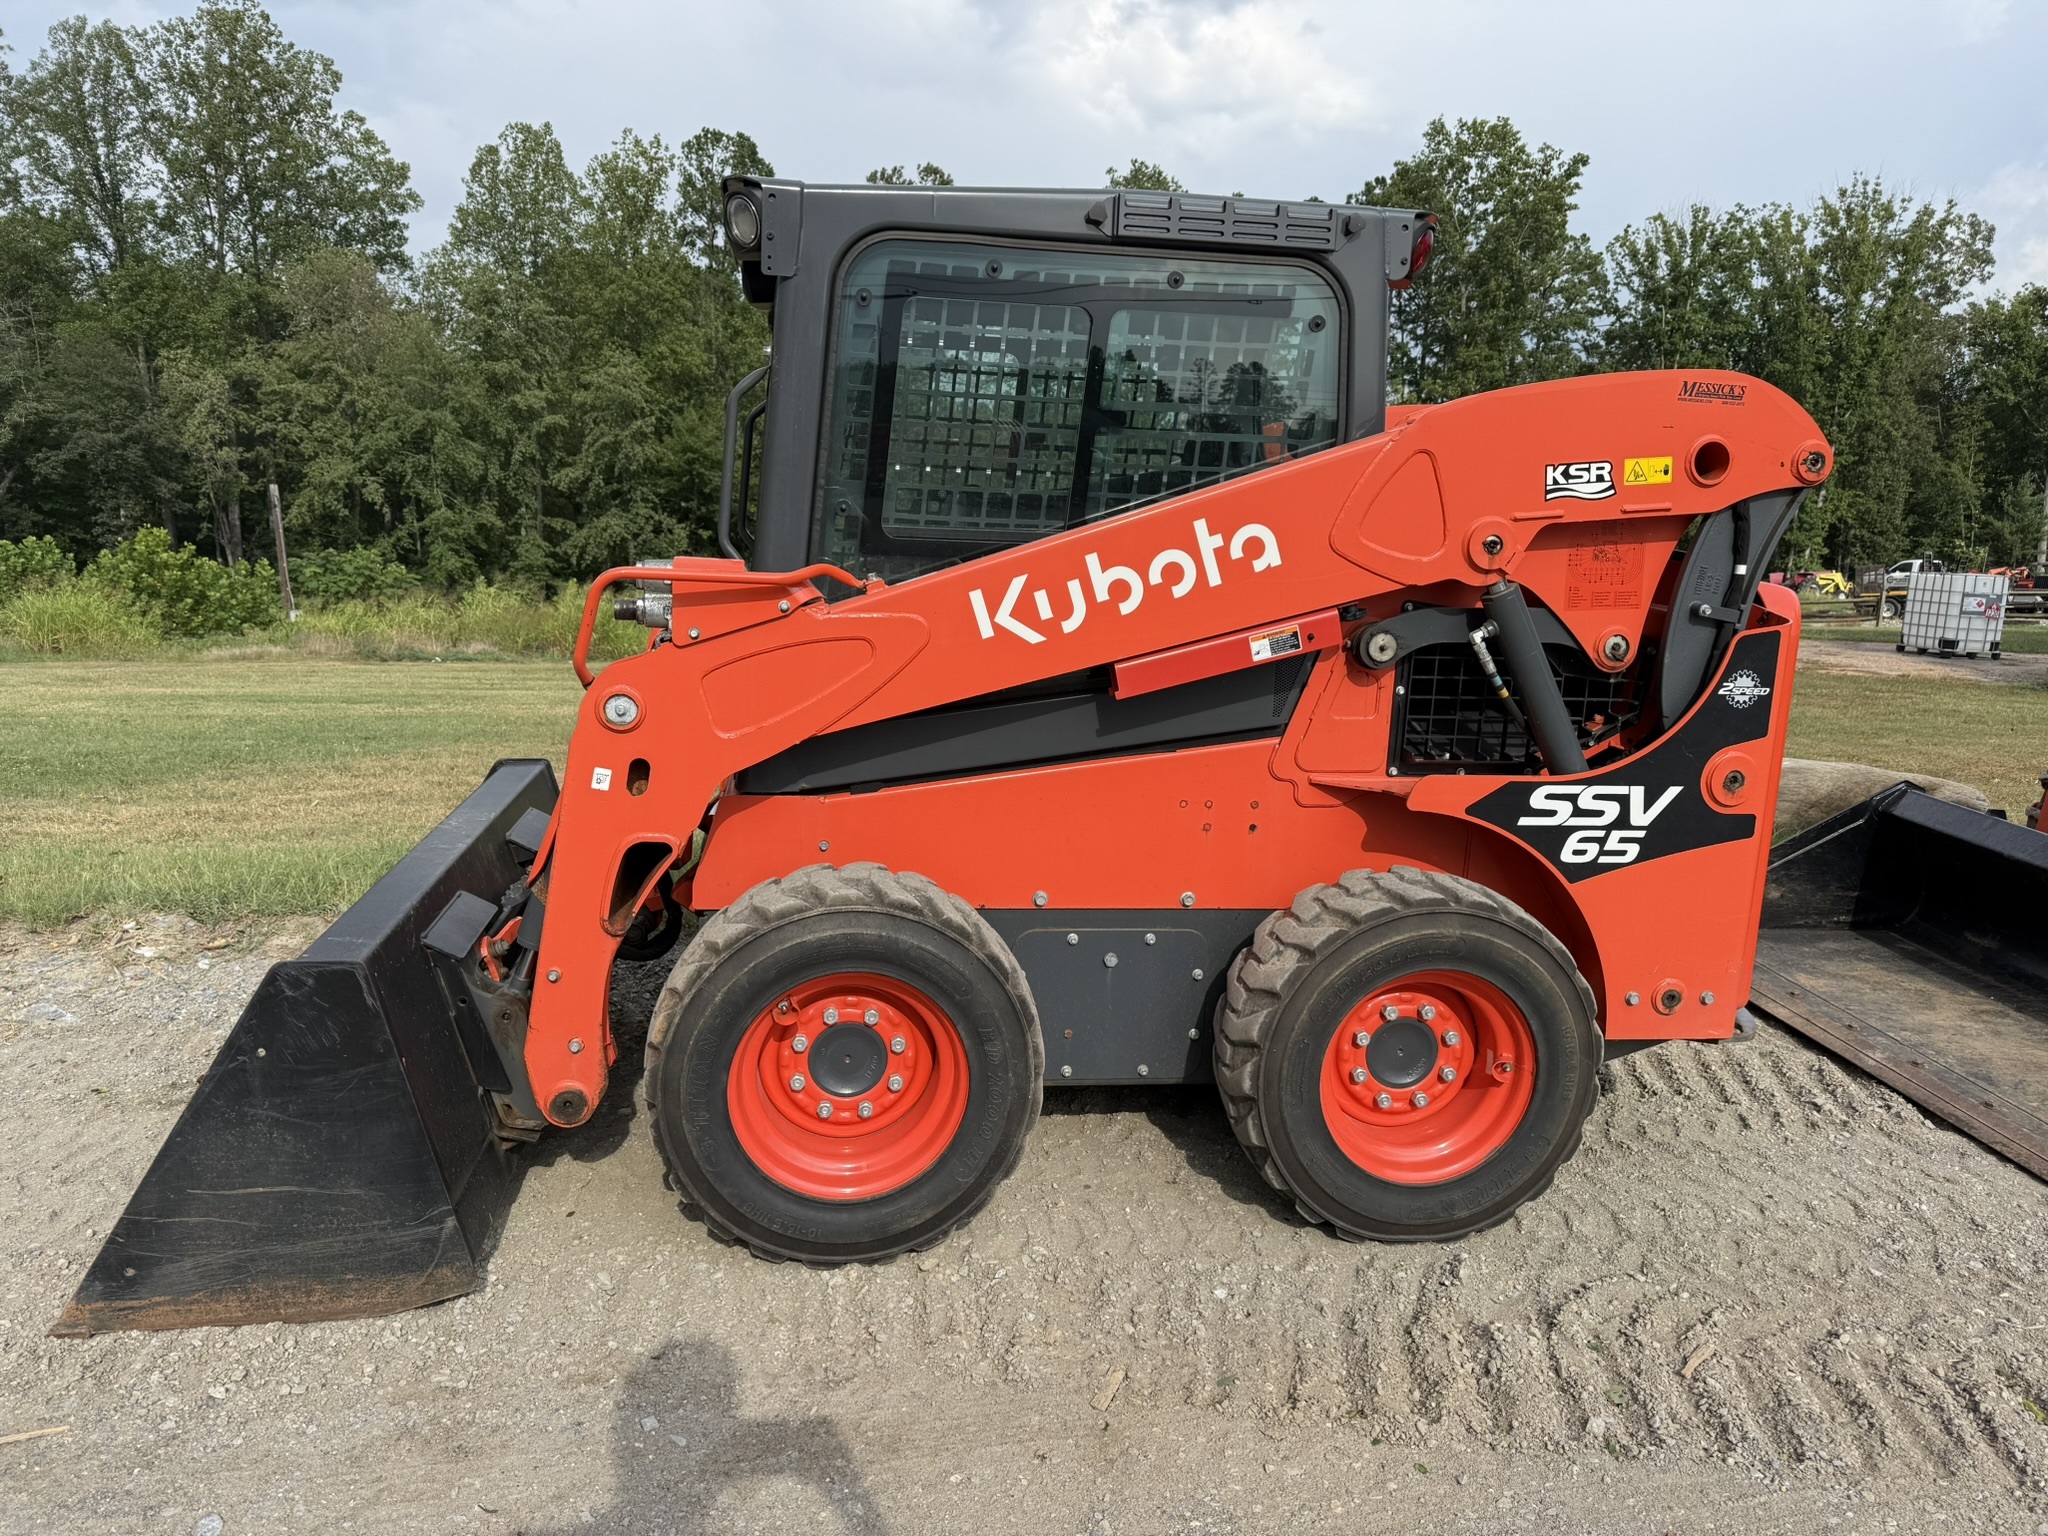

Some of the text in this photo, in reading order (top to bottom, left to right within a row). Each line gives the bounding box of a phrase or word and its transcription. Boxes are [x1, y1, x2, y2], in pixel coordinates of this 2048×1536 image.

[1678, 381, 1747, 398] MESSICK'S
[1546, 462, 1612, 485] KSR
[967, 517, 1283, 645] Kubota
[1516, 785, 1685, 827] SSV
[1559, 830, 1648, 864] 65
[689, 1033, 721, 1134] TITAN
[980, 1073, 1004, 1139] 2000
